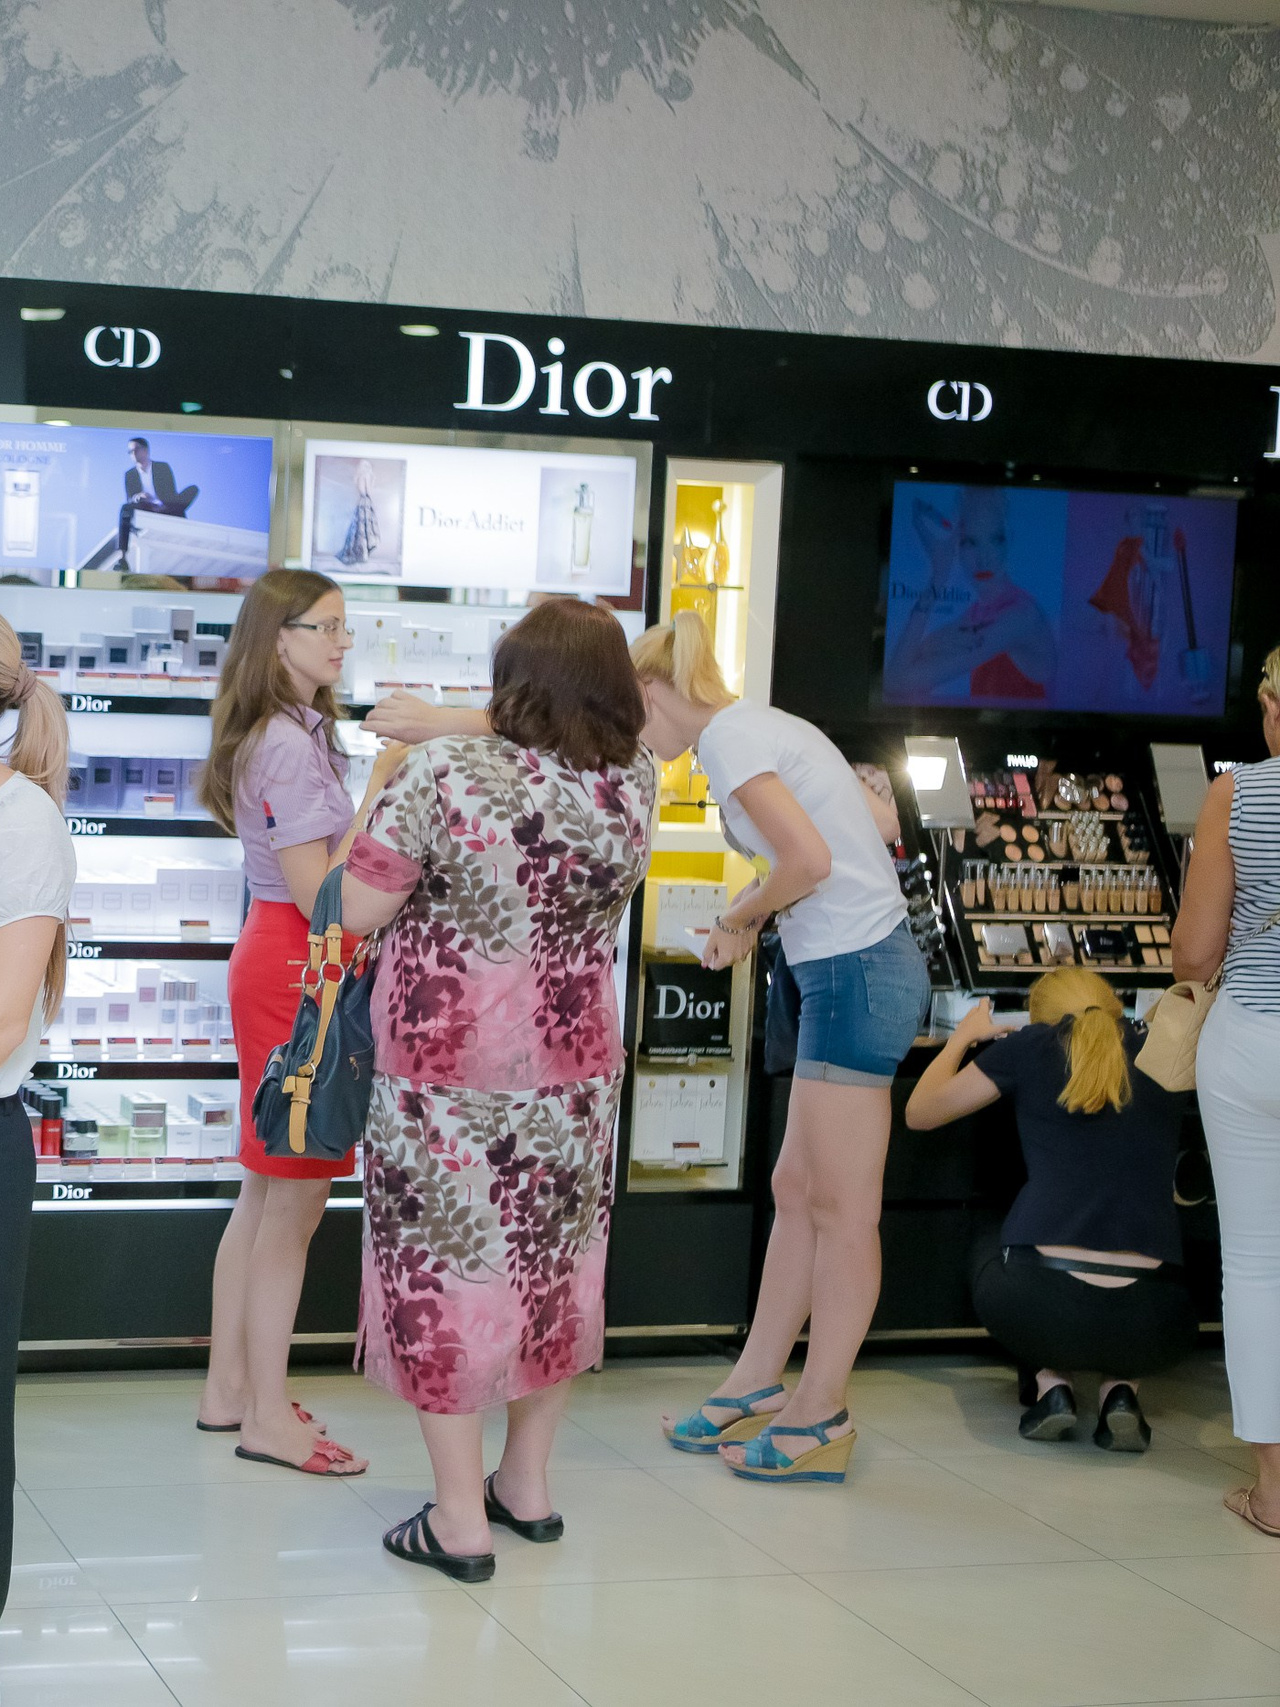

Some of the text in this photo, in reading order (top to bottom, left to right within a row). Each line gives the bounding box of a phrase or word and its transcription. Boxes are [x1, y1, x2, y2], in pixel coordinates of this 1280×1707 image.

[454, 331, 673, 422] Dior
[16, 440, 68, 453] HOMME
[418, 505, 524, 532] Dior Addict
[71, 695, 112, 712] Dior
[67, 818, 107, 835] Dior
[67, 942, 102, 958] Dior
[653, 985, 725, 1020] Dior
[56, 1063, 98, 1079] Dior
[52, 1184, 93, 1200] Dior
